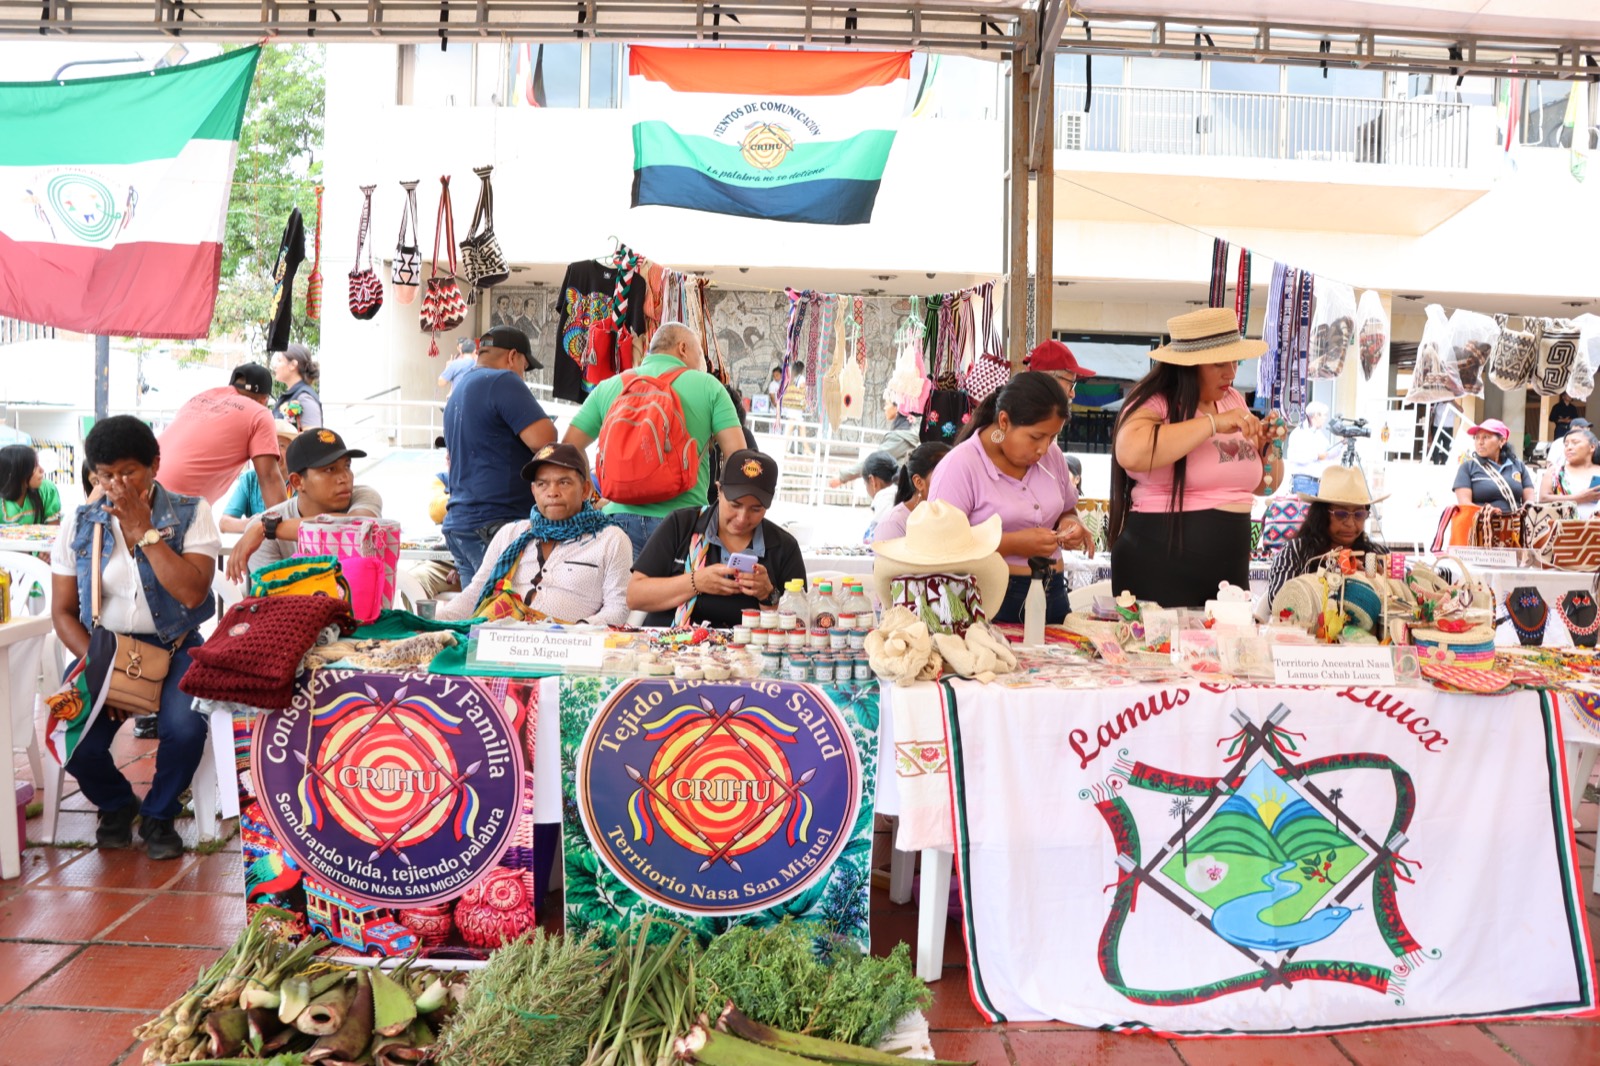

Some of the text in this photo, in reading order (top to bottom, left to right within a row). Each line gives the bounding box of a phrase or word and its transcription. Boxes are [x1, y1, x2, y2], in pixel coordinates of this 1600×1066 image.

[744, 102, 759, 114] DE
[750, 143, 783, 151] CRIHU
[718, 170, 761, 182] palabra
[490, 631, 592, 647] Territorio Ancestral
[509, 646, 569, 659] San Miguel
[1275, 658, 1390, 669] Territorio Ancestral Nasa
[1287, 670, 1319, 679] Lamus
[1353, 671, 1381, 680] Luucx
[436, 677, 460, 699] y
[456, 689, 511, 779] Familia
[599, 690, 664, 753] Tejido
[785, 692, 843, 761] Salud
[1068, 685, 1450, 770] Lamus Luucx
[338, 764, 438, 794] CRIHU
[671, 778, 773, 803] CRIHU
[275, 792, 505, 884] Sembrando Vida, tejiendo palabra
[306, 851, 474, 896] TERRITORIO NASA SAN MIGUEL
[607, 825, 833, 900] Territorio Nasa San Miguel
